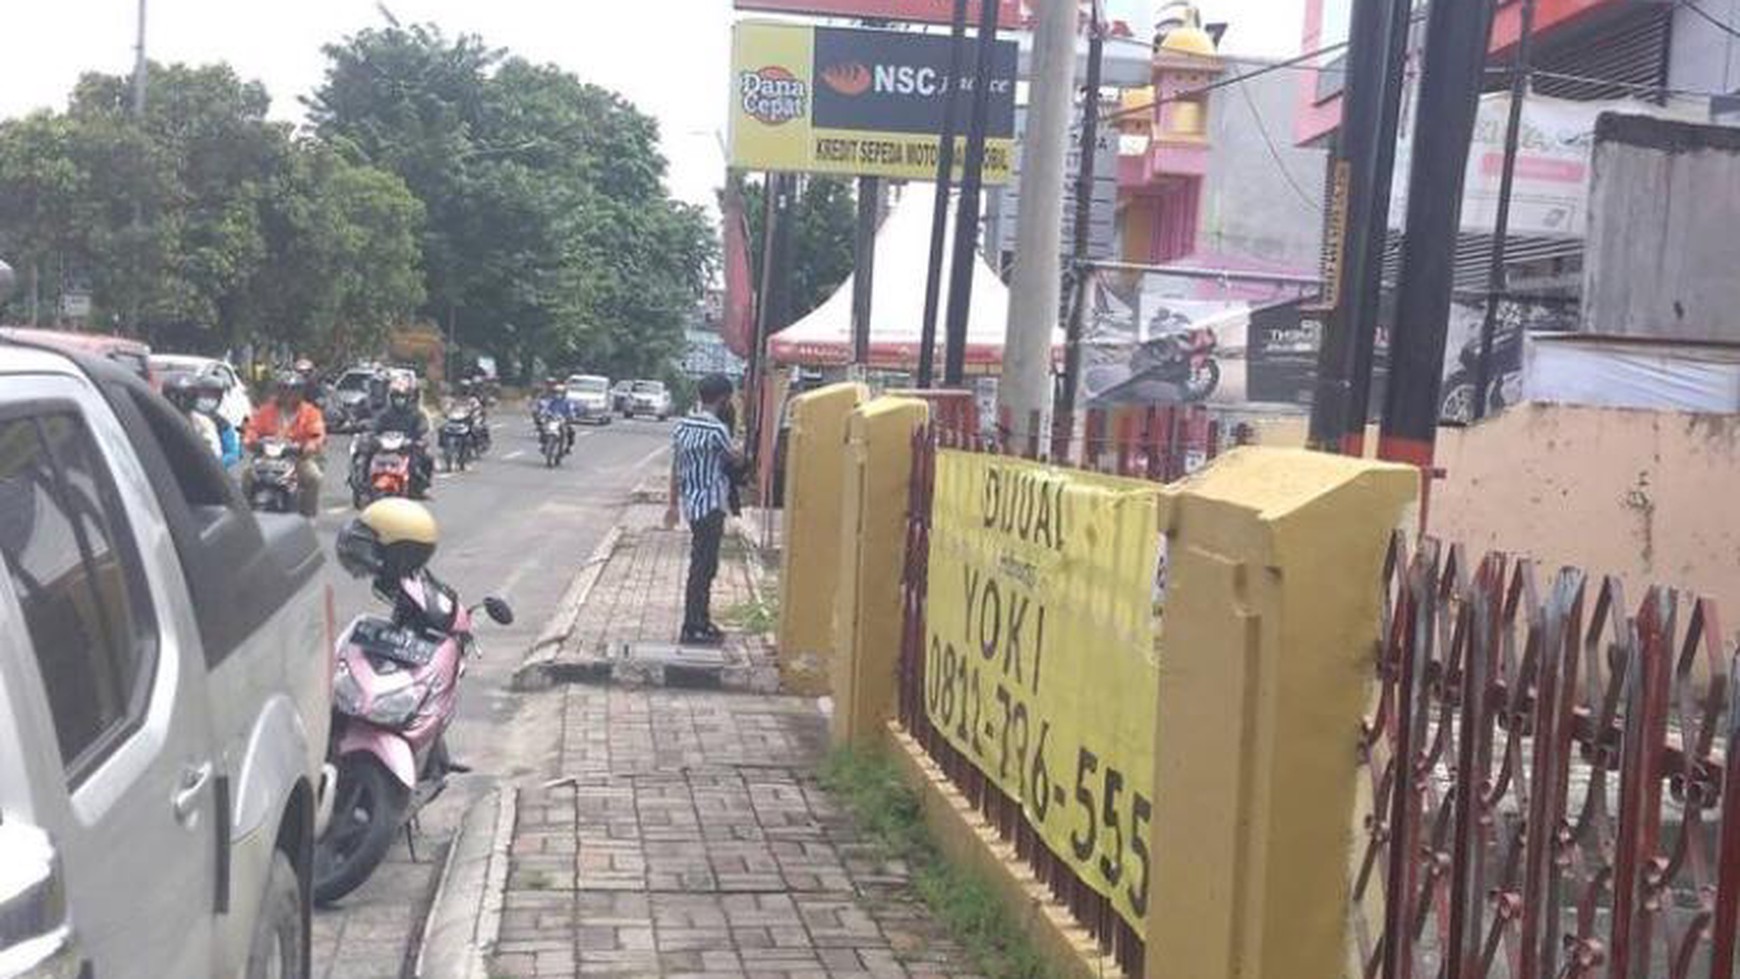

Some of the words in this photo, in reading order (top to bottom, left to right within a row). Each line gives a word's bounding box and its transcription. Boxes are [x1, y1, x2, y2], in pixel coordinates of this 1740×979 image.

[741, 73, 804, 97] Dana
[873, 64, 936, 95] NSC
[743, 93, 805, 121] Cepat
[905, 143, 938, 167] MOTO
[983, 467, 1065, 551] DIJUAL
[964, 563, 1045, 696] YOKI
